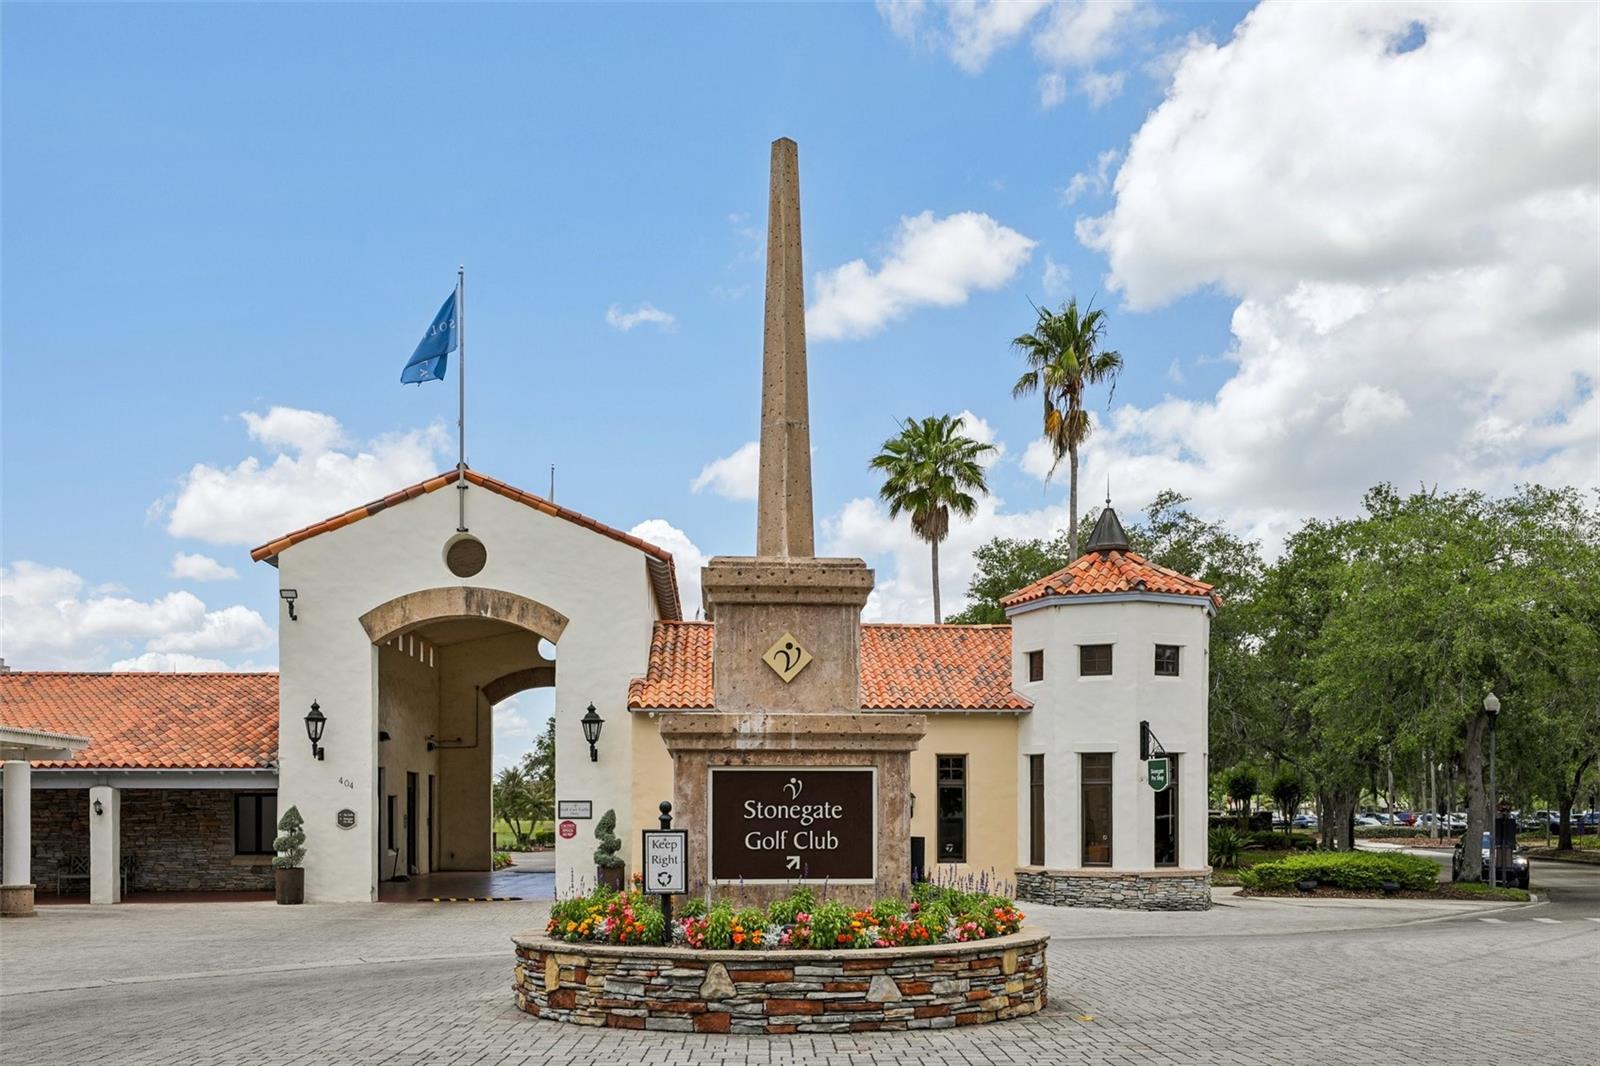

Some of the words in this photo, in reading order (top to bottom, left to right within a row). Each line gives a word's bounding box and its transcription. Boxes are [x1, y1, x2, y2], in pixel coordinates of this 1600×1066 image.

[338, 776, 354, 790] 404
[743, 799, 843, 826] Stonegate
[652, 839, 678, 852] Keep
[745, 830, 789, 850] Golf
[793, 830, 839, 850] Club
[651, 855, 678, 868] Right
